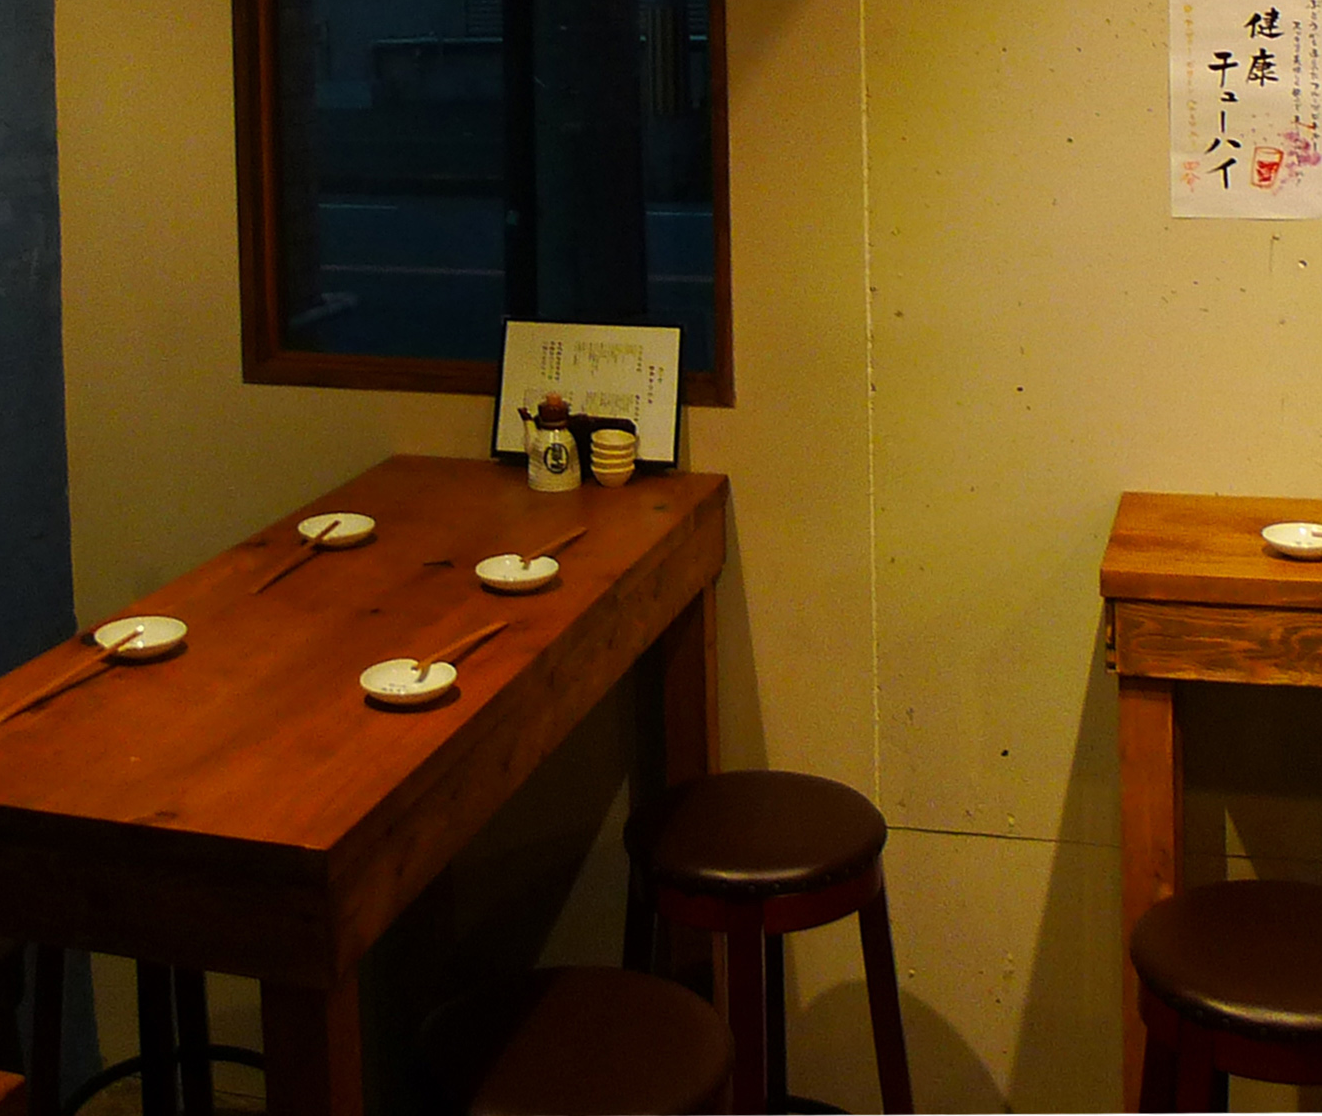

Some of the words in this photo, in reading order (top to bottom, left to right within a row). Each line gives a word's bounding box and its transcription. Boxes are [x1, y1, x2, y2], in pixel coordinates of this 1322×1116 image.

[1243, 6, 1285, 88] 健康
[1204, 51, 1242, 190] チューハイ
